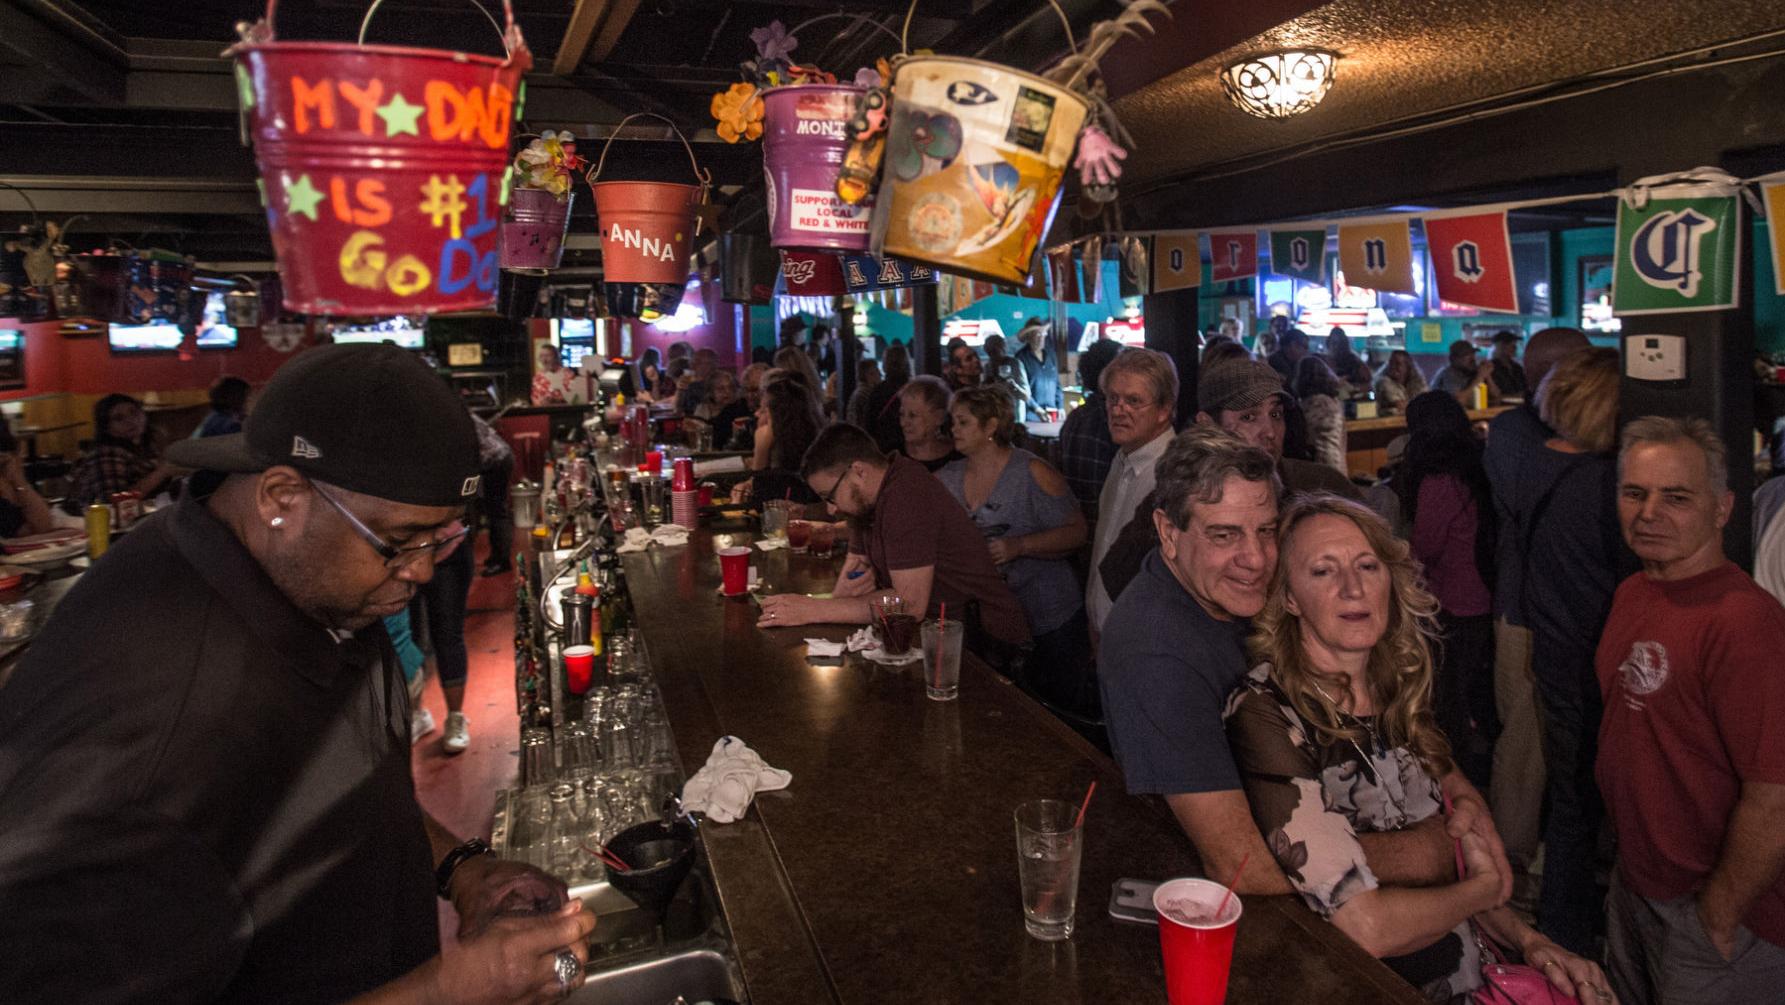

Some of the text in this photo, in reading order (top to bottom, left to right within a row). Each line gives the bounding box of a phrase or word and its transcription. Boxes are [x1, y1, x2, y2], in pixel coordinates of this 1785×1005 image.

[291, 75, 384, 135] MY
[418, 172, 497, 241] #1
[799, 217, 820, 227] RED
[817, 208, 853, 218] LOCAL
[610, 223, 675, 262] ANNA
